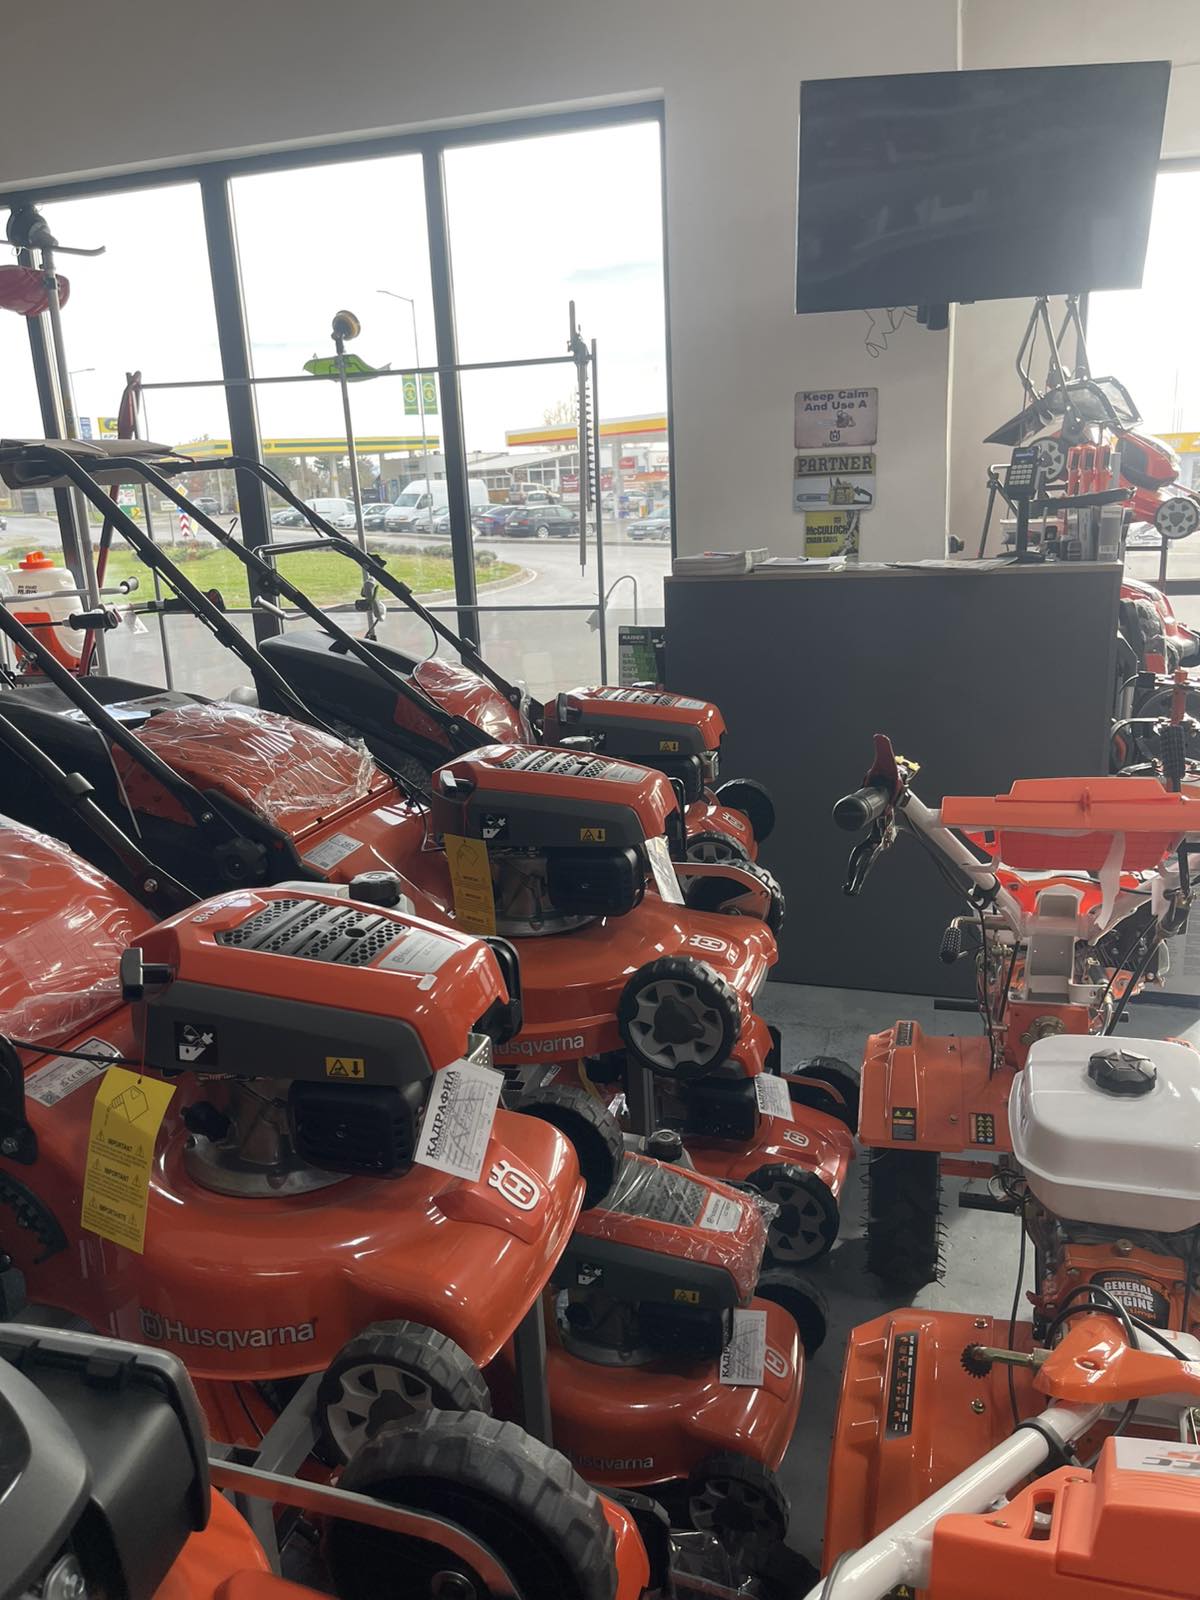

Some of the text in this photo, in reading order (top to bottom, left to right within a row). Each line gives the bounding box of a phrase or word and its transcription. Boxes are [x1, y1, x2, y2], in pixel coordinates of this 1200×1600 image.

[803, 390, 869, 401] Keep Calm
[804, 400, 867, 411] And Use A
[798, 455, 873, 473] PARTNER
[494, 1035, 585, 1056] usqvarna
[426, 1070, 457, 1158] КАДРАФИЛ
[1104, 1281, 1153, 1296] GENERAL
[1107, 1296, 1154, 1312] NGINE
[164, 1317, 315, 1351] Husqvarna
